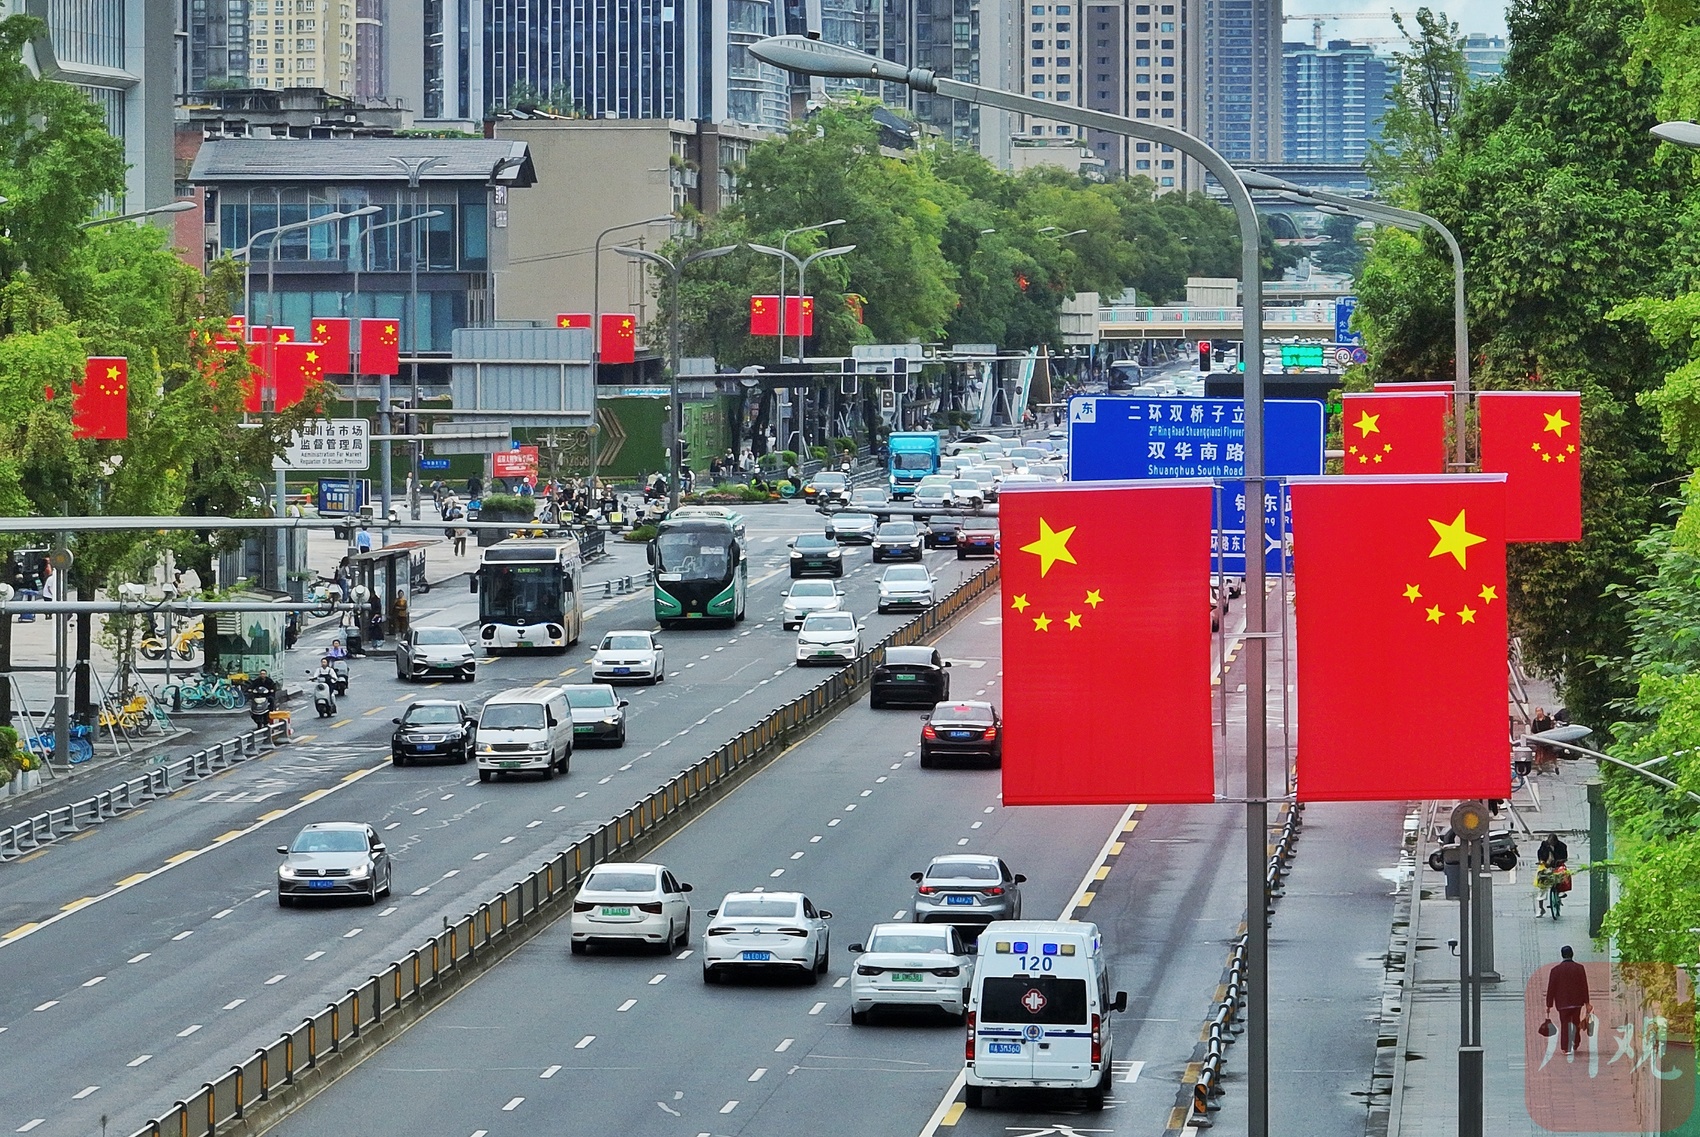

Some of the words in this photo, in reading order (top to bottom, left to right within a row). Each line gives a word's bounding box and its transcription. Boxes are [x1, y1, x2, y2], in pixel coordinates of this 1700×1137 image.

[1081, 402, 1093, 414] 东
[1158, 425, 1171, 439] Ring
[1172, 425, 1185, 437] Road
[300, 439, 363, 450] 监督管理局
[1147, 442, 1245, 462] 双华南路
[1148, 464, 1195, 478] Shuanghua
[1197, 465, 1221, 476] South
[1223, 465, 1244, 476] Road
[1019, 956, 1053, 971] 120
